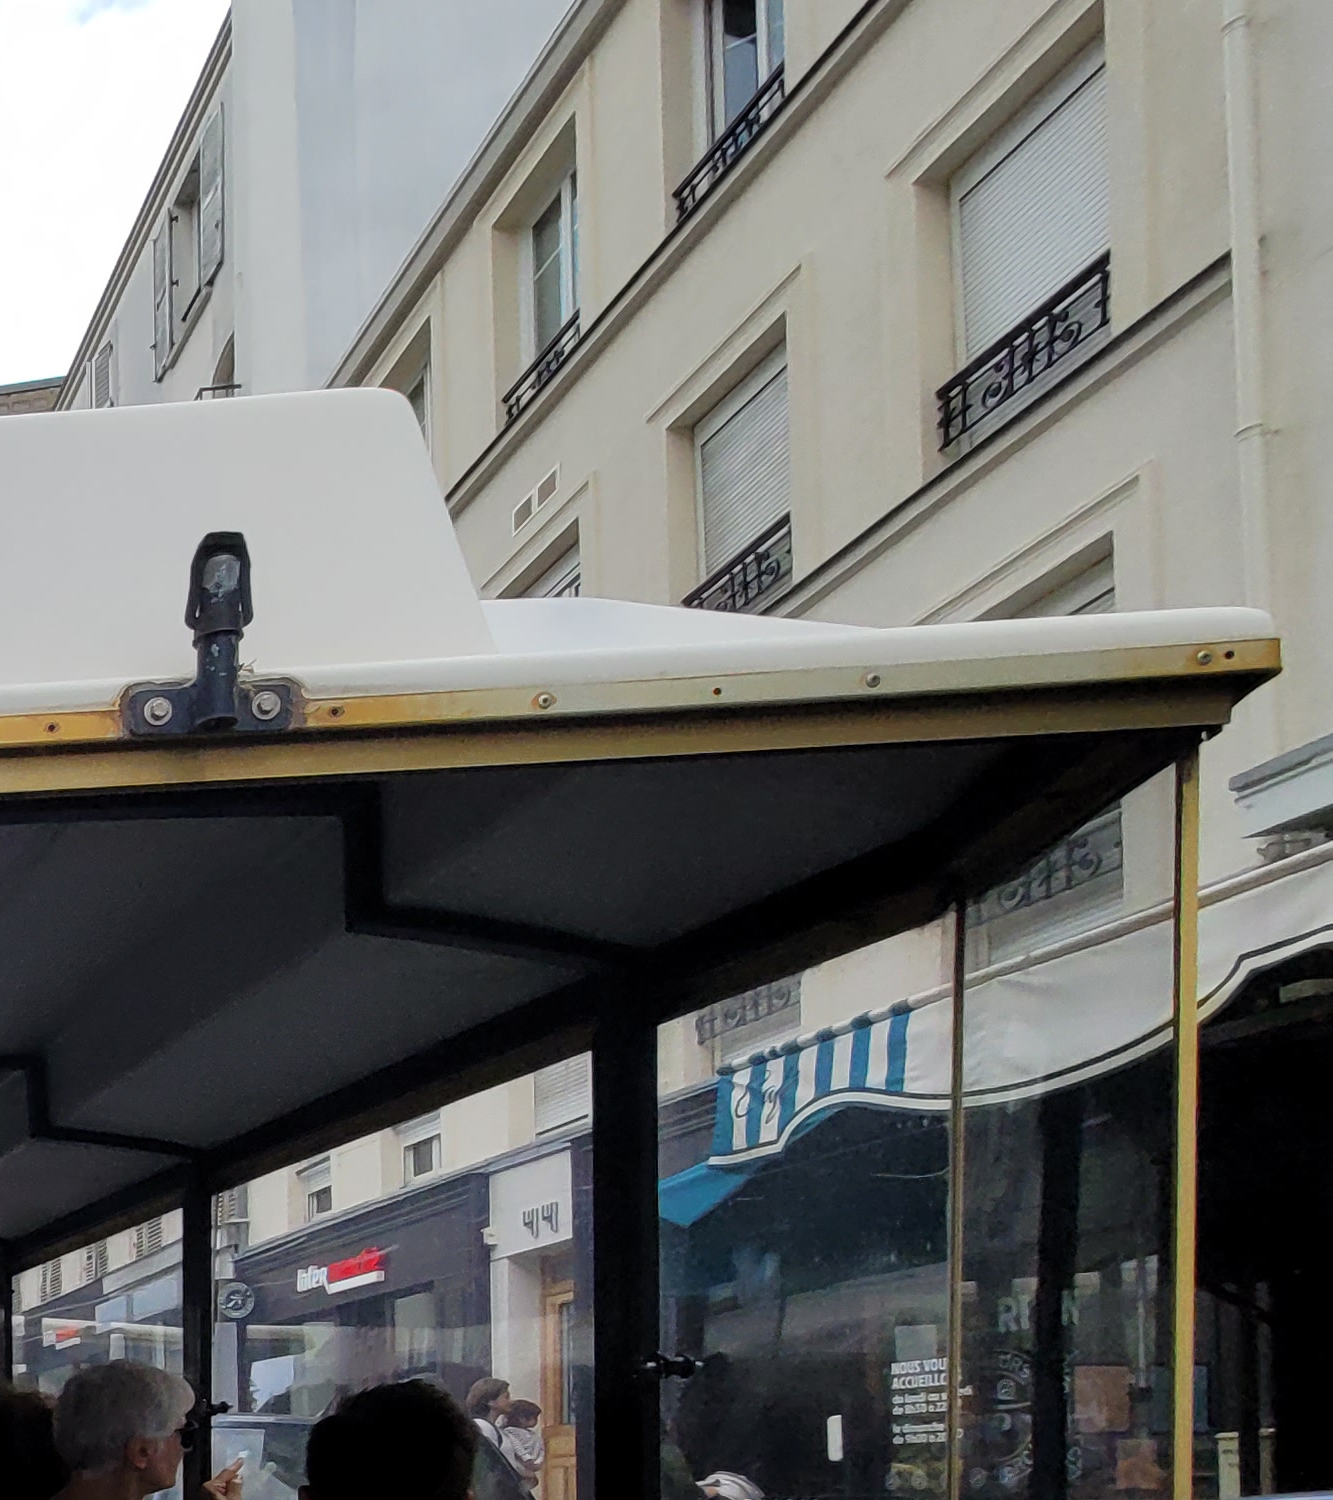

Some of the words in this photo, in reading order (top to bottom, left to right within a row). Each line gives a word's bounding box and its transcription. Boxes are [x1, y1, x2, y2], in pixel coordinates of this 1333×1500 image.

[522, 1201, 559, 1239] 44
[891, 1361, 921, 1375] NOUS
[922, 1357, 948, 1372] VOU
